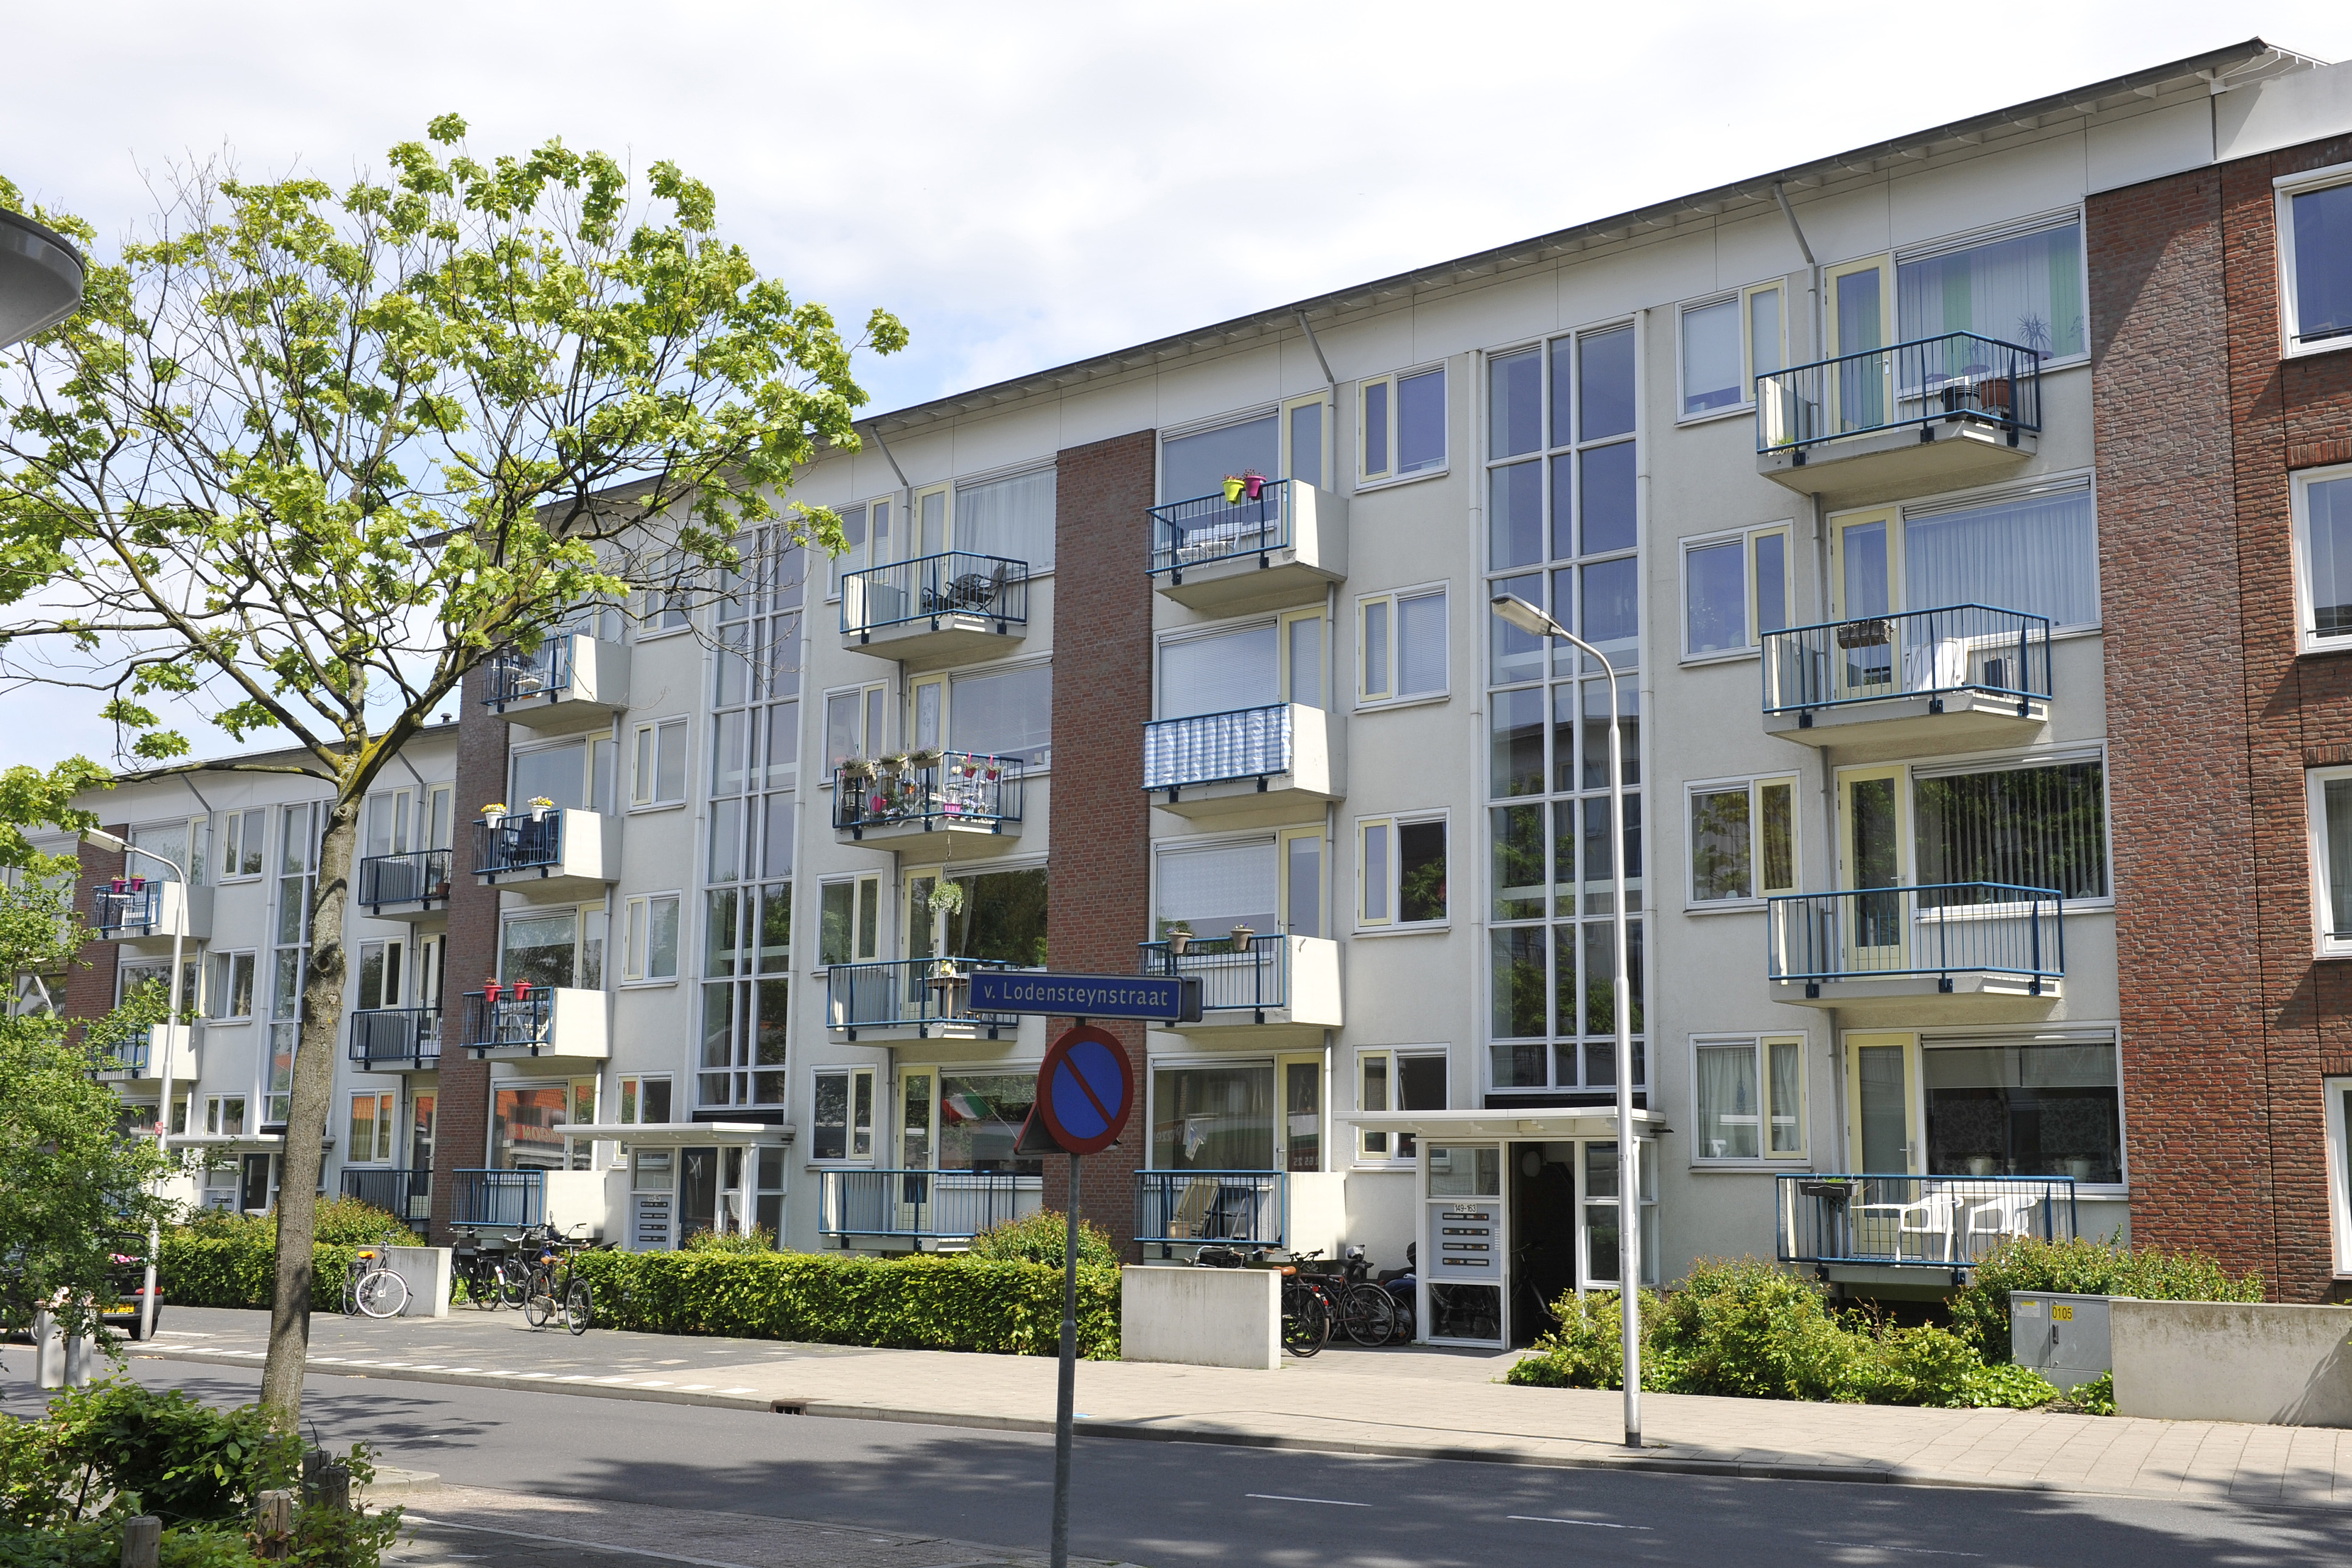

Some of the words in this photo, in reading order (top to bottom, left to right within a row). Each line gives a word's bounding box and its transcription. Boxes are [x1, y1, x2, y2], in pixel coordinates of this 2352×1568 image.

[984, 984, 995, 999] v.
[1003, 982, 1168, 1006] Lodensteynstraat
[1455, 1204, 1476, 1213] 149-163
[2052, 1307, 2073, 1320] 0105
